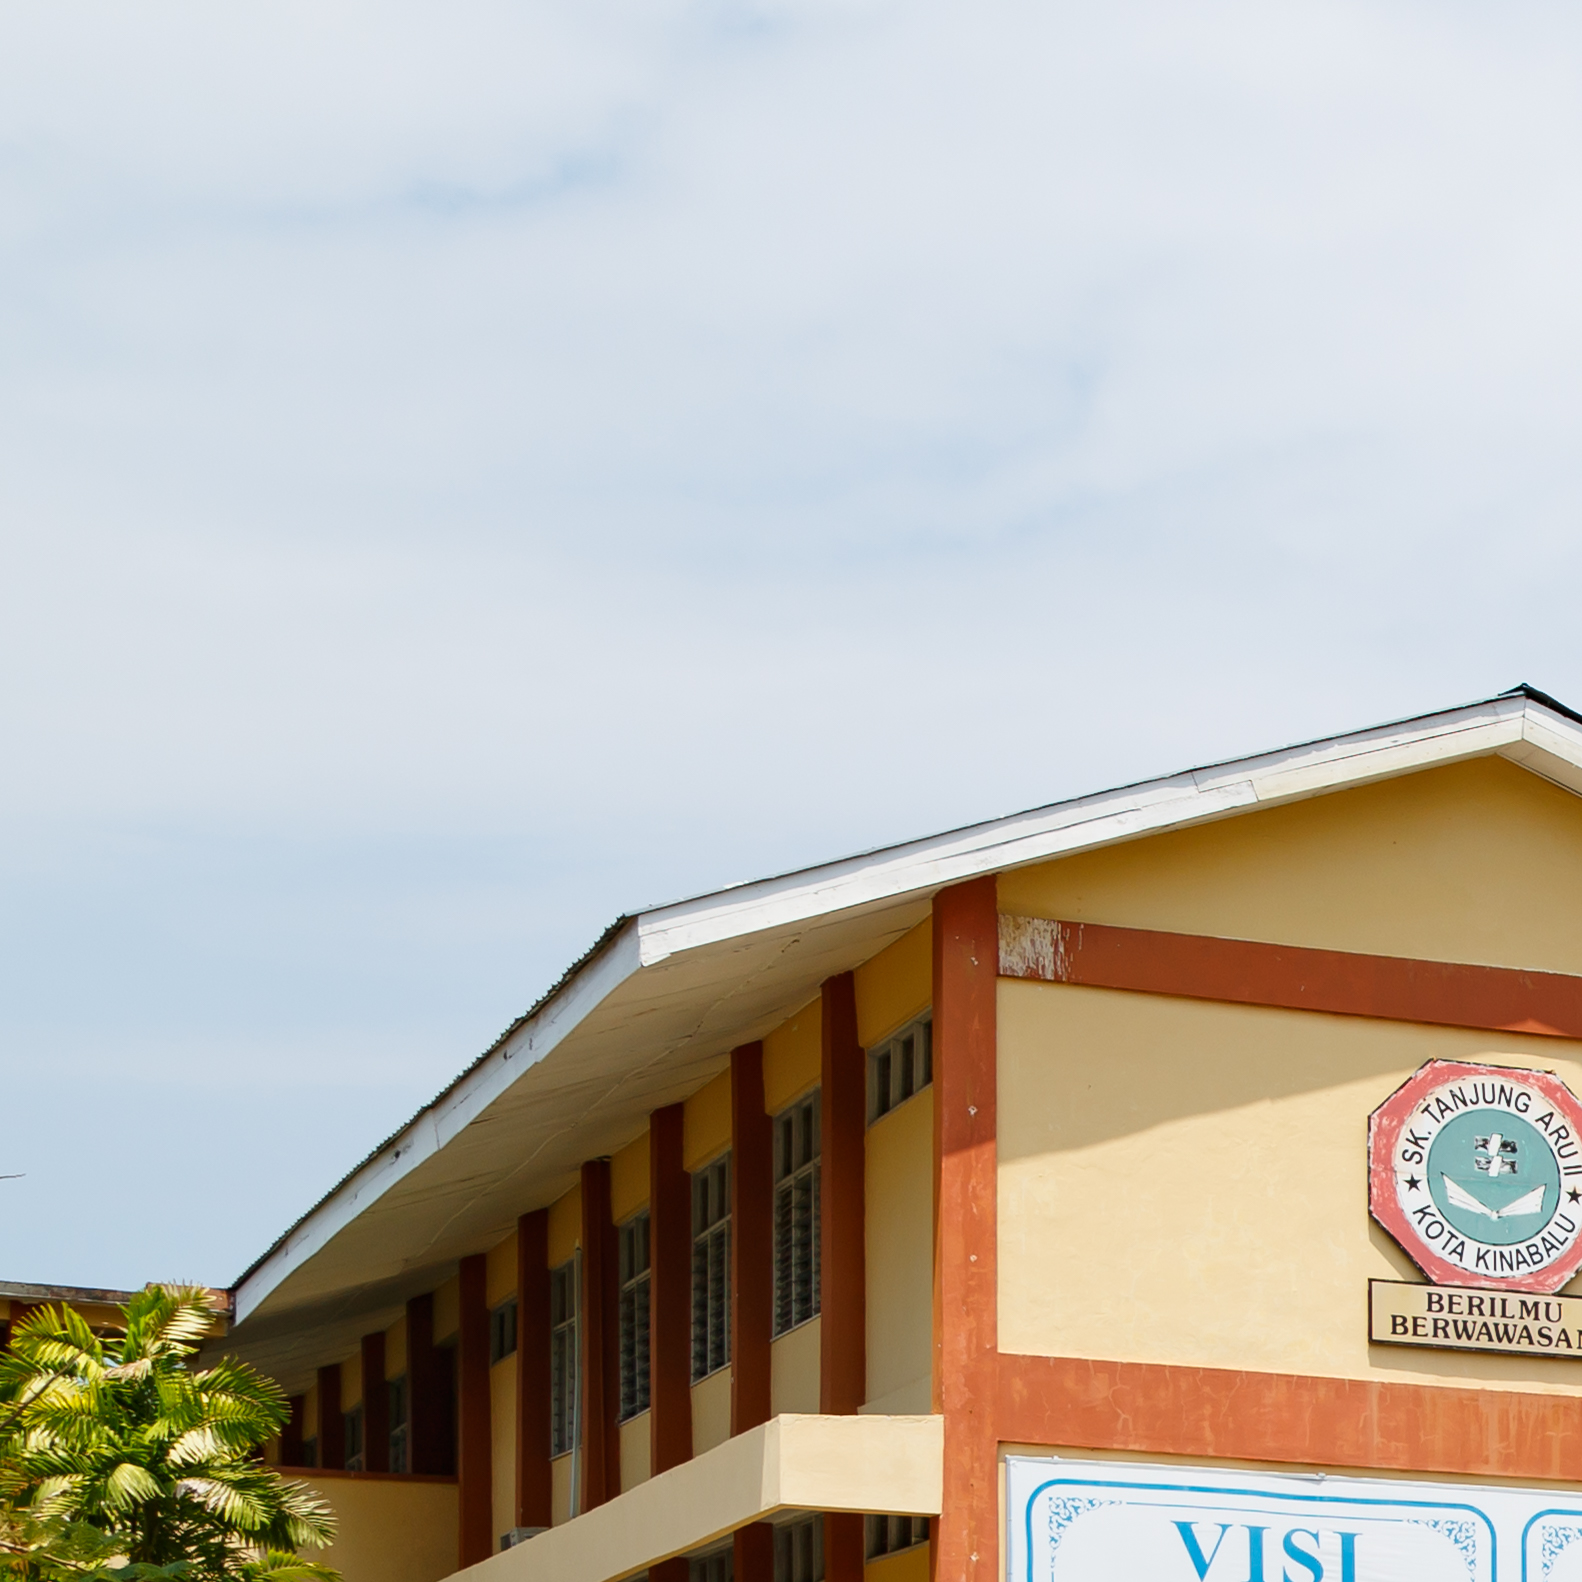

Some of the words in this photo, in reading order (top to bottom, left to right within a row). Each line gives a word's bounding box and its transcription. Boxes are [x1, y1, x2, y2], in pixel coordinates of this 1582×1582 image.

[1401, 1128, 1432, 1165] SK.
[1421, 1082, 1532, 1124] TANJUNG
[1535, 1111, 1579, 1160] ARU
[1562, 1164, 1582, 1176] II
[1412, 1204, 1466, 1262] KOTA
[1475, 1213, 1576, 1271] KINABALU
[1426, 1292, 1563, 1323] BERILMU
